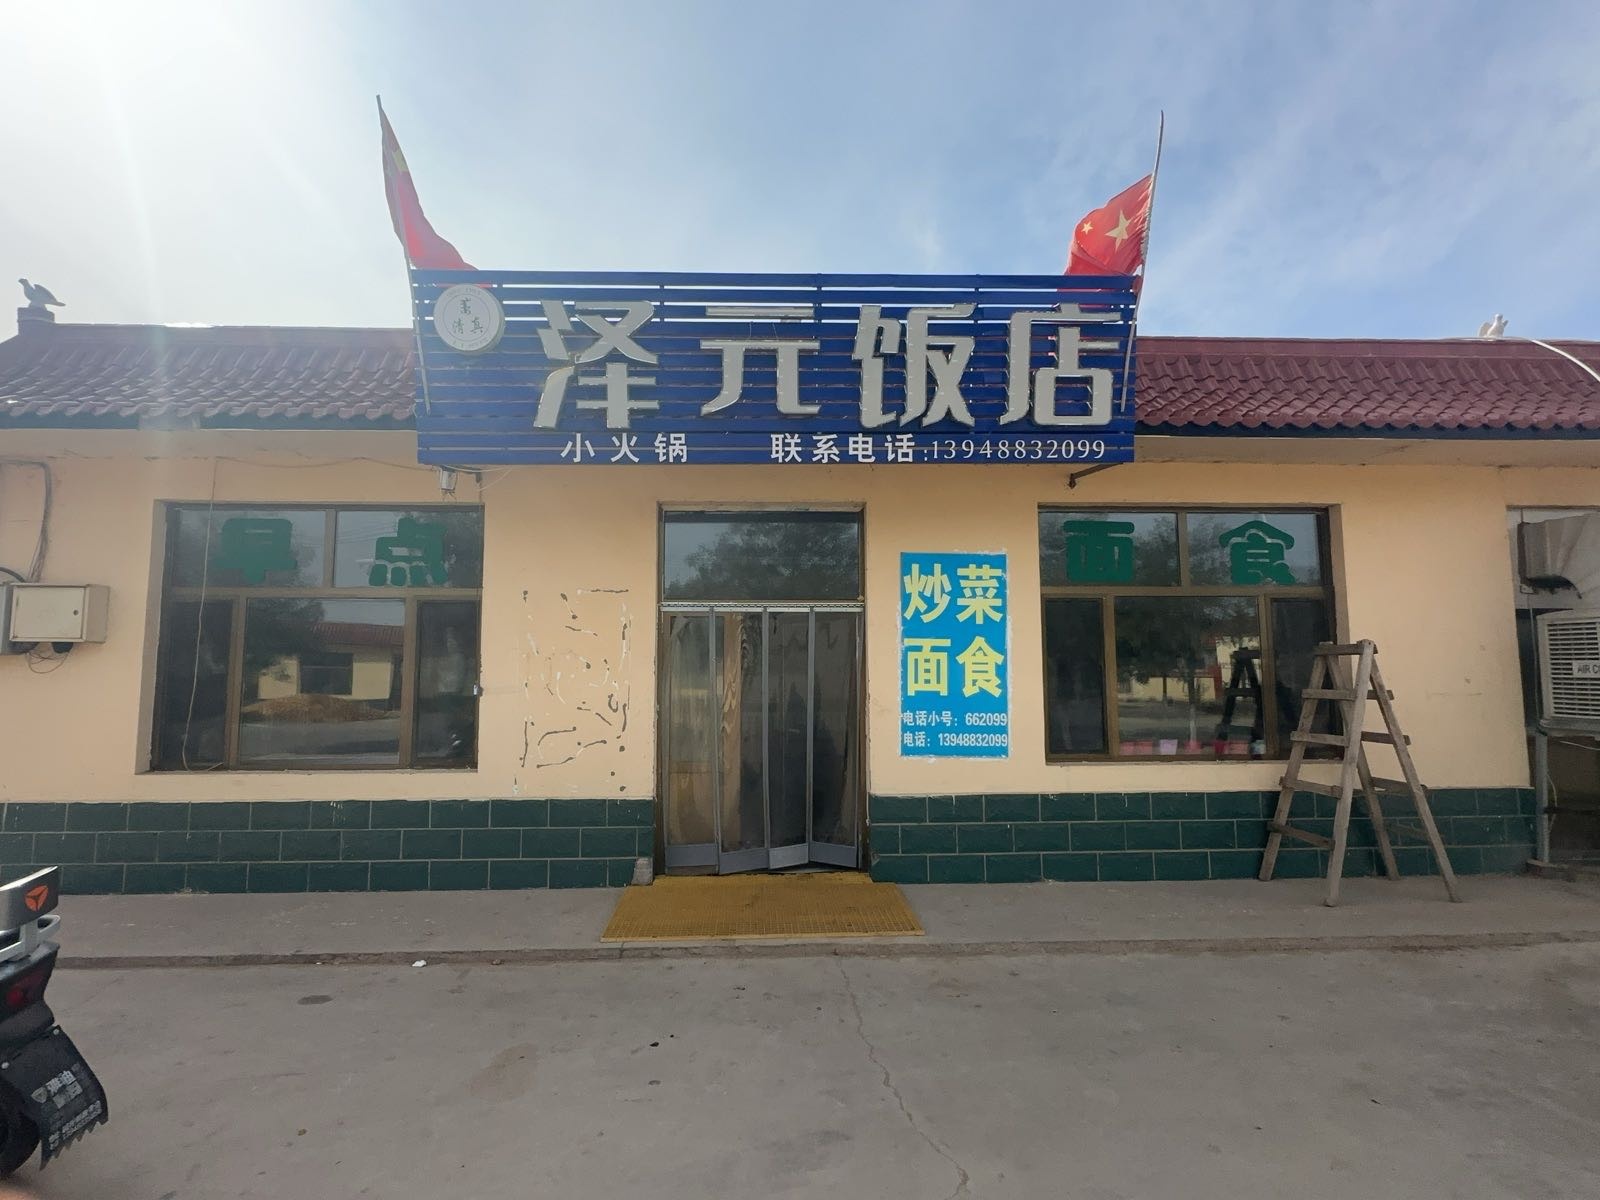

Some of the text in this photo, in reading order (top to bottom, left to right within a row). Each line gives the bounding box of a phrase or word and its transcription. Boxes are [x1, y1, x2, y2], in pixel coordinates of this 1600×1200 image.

[533, 299, 1122, 430] 泽元饭店
[560, 432, 687, 463] 小火锅
[903, 563, 1004, 625] 炒菜
[903, 635, 1005, 698] 面食
[1577, 664, 1591, 673] AIR
